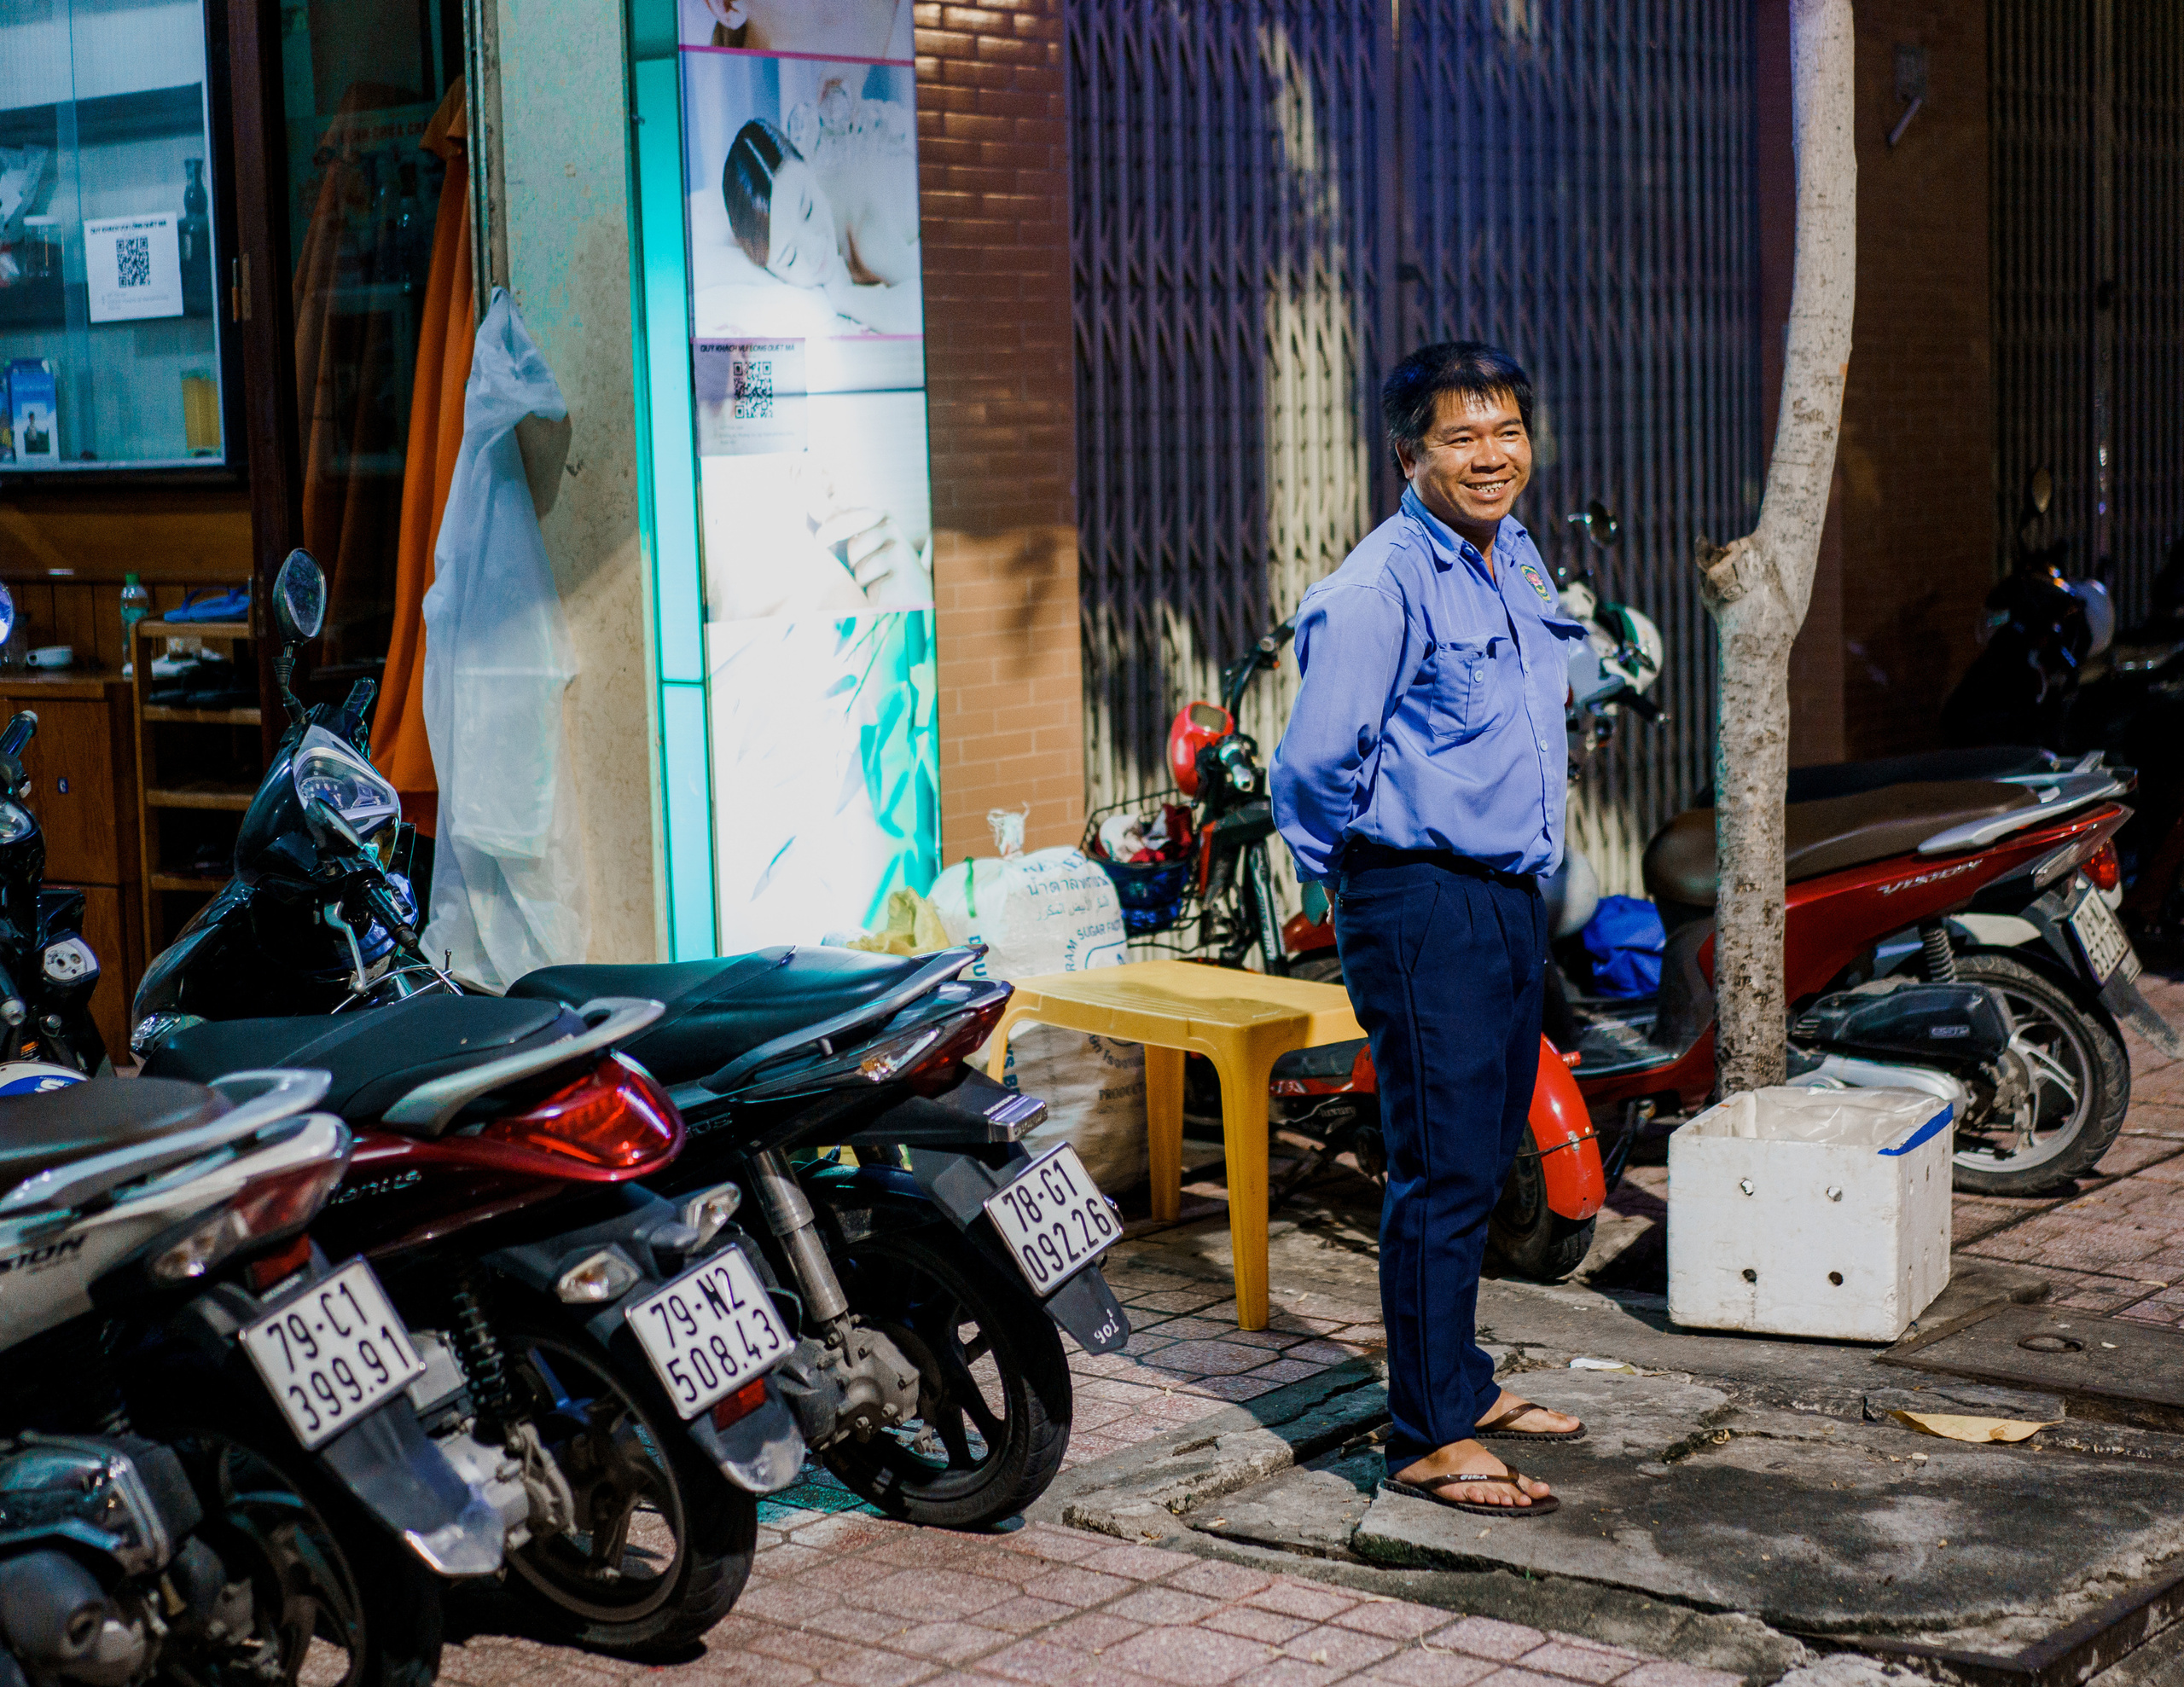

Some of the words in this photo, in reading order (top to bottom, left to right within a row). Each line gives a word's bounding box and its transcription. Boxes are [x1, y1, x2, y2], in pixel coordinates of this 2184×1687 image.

[1876, 857, 1984, 896] VISION
[1001, 1159, 1078, 1233] 78-G1
[1022, 1197, 1112, 1284] 092.26
[266, 1281, 368, 1373] 79-C1
[649, 1267, 746, 1348] 79-N2
[289, 1325, 410, 1431] 399.91
[666, 1308, 780, 1402] 508.43
